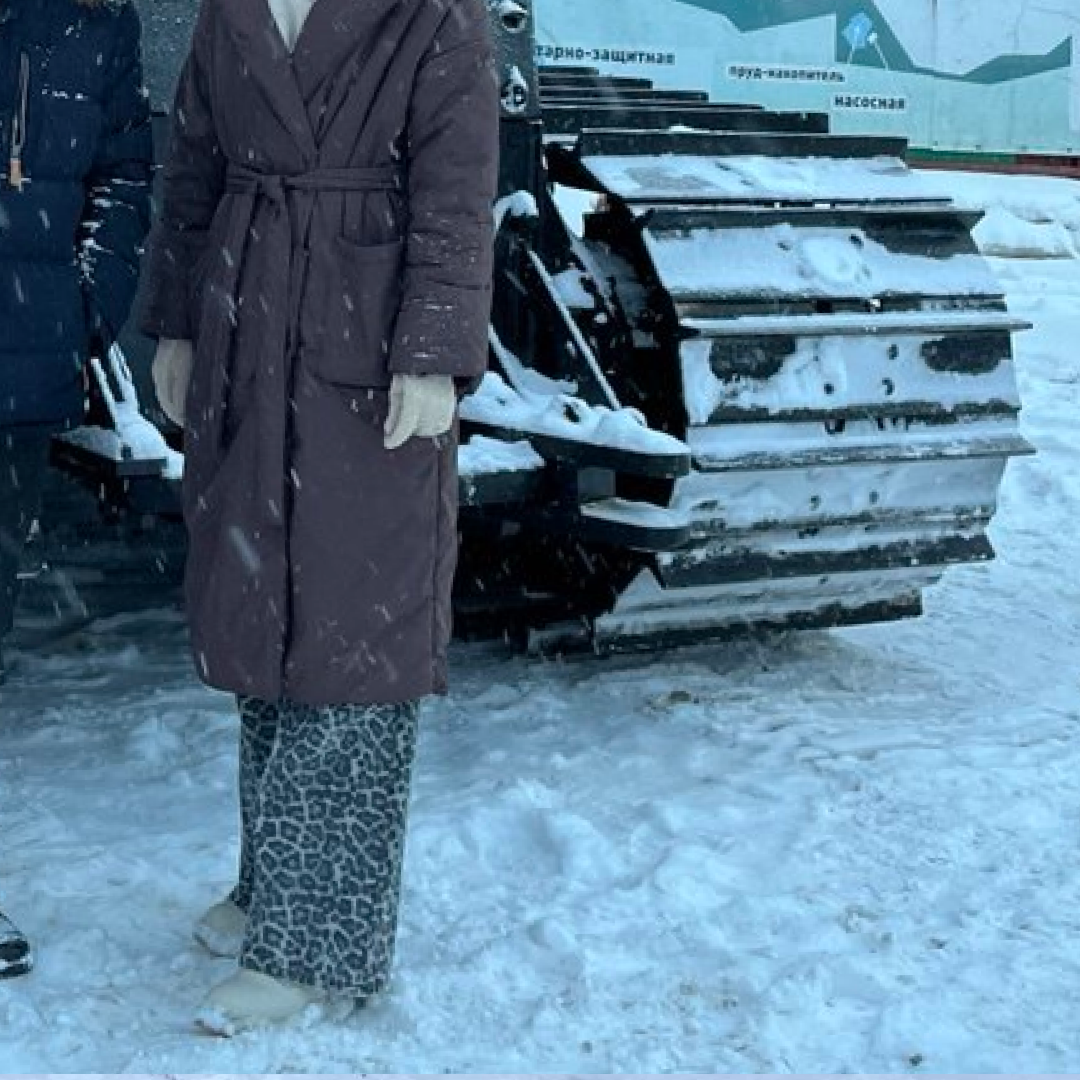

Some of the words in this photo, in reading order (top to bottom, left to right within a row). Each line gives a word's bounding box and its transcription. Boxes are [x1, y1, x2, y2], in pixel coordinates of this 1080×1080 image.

[535, 44, 676, 66] тарно-защитная
[729, 65, 845, 82] пруд-накопитель
[834, 94, 905, 109] насосная
